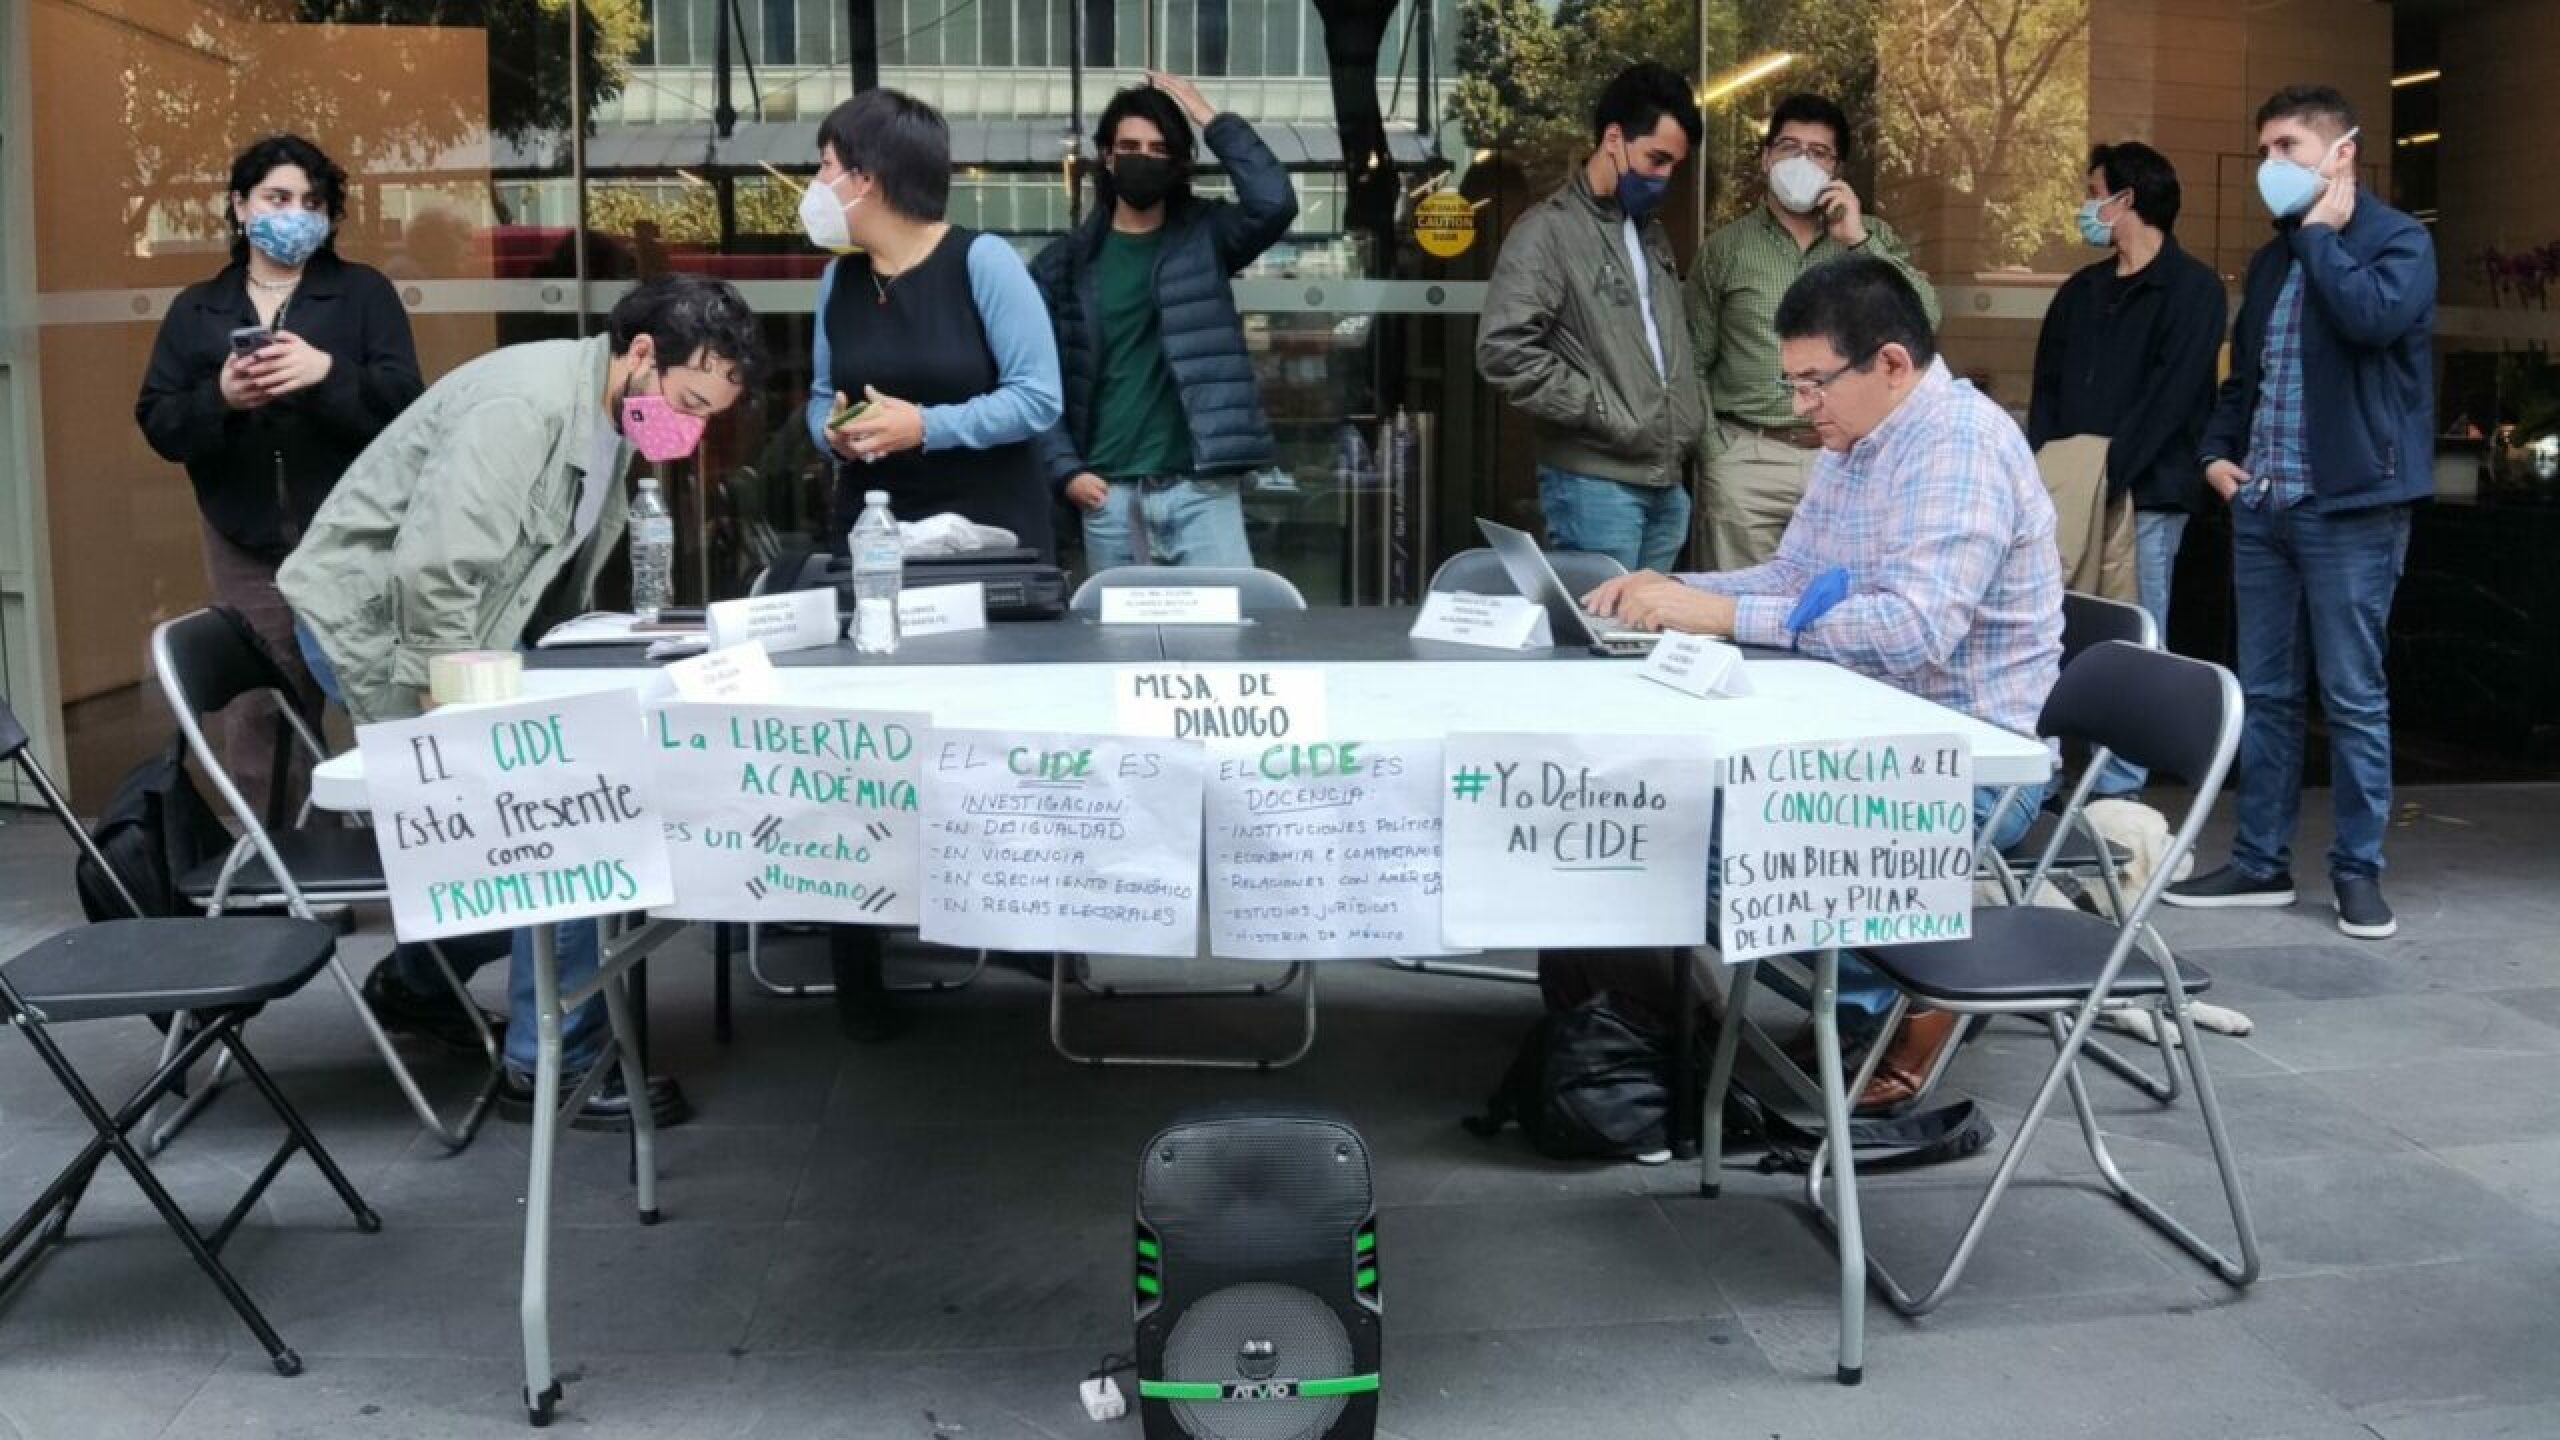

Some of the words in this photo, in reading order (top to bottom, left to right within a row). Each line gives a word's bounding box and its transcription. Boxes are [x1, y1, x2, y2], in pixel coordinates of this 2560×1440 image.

[1416, 214, 1473, 228] CAUTION
[1134, 673, 1213, 701] MESA
[1239, 673, 1277, 697] DE
[410, 734, 453, 784] EL
[491, 714, 576, 771] CIDE
[730, 716, 914, 761] LIBERTAD
[938, 741, 988, 772] EL
[1007, 746, 1097, 781] CIDE
[1118, 753, 1162, 780] ES
[1218, 759, 1257, 782] EL
[1258, 740, 1366, 781] CIDE
[1371, 755, 1405, 779] ES
[1728, 754, 1757, 785] LA
[1768, 745, 1900, 783] CIENCIA
[1936, 749, 1961, 778] EL
[495, 774, 643, 838] Presente
[1763, 790, 1967, 835] CONOCIMIENTO
[705, 828, 743, 849] un
[983, 818, 1127, 842] DESIGUALDAD
[1231, 817, 1367, 840] INSTITUCIONES
[1554, 818, 1649, 863] CIDE
[486, 842, 555, 867] como
[981, 846, 1086, 865] VIOLENCIA
[1723, 852, 1756, 887] ES
[1763, 850, 1797, 882] UN
[1804, 845, 1859, 878] BIEN
[428, 859, 639, 925] PROMETIMOS
[981, 870, 1109, 890] CRECIMIENTO
[1338, 872, 1370, 887] CON
[981, 895, 1052, 916] REGLAS
[1057, 903, 1177, 928] ELECTORALES
[1730, 889, 1814, 925] SOCIAL
[1847, 884, 1928, 914] PILAR
[1735, 929, 1760, 952] DE
[1767, 922, 1798, 947] LA
